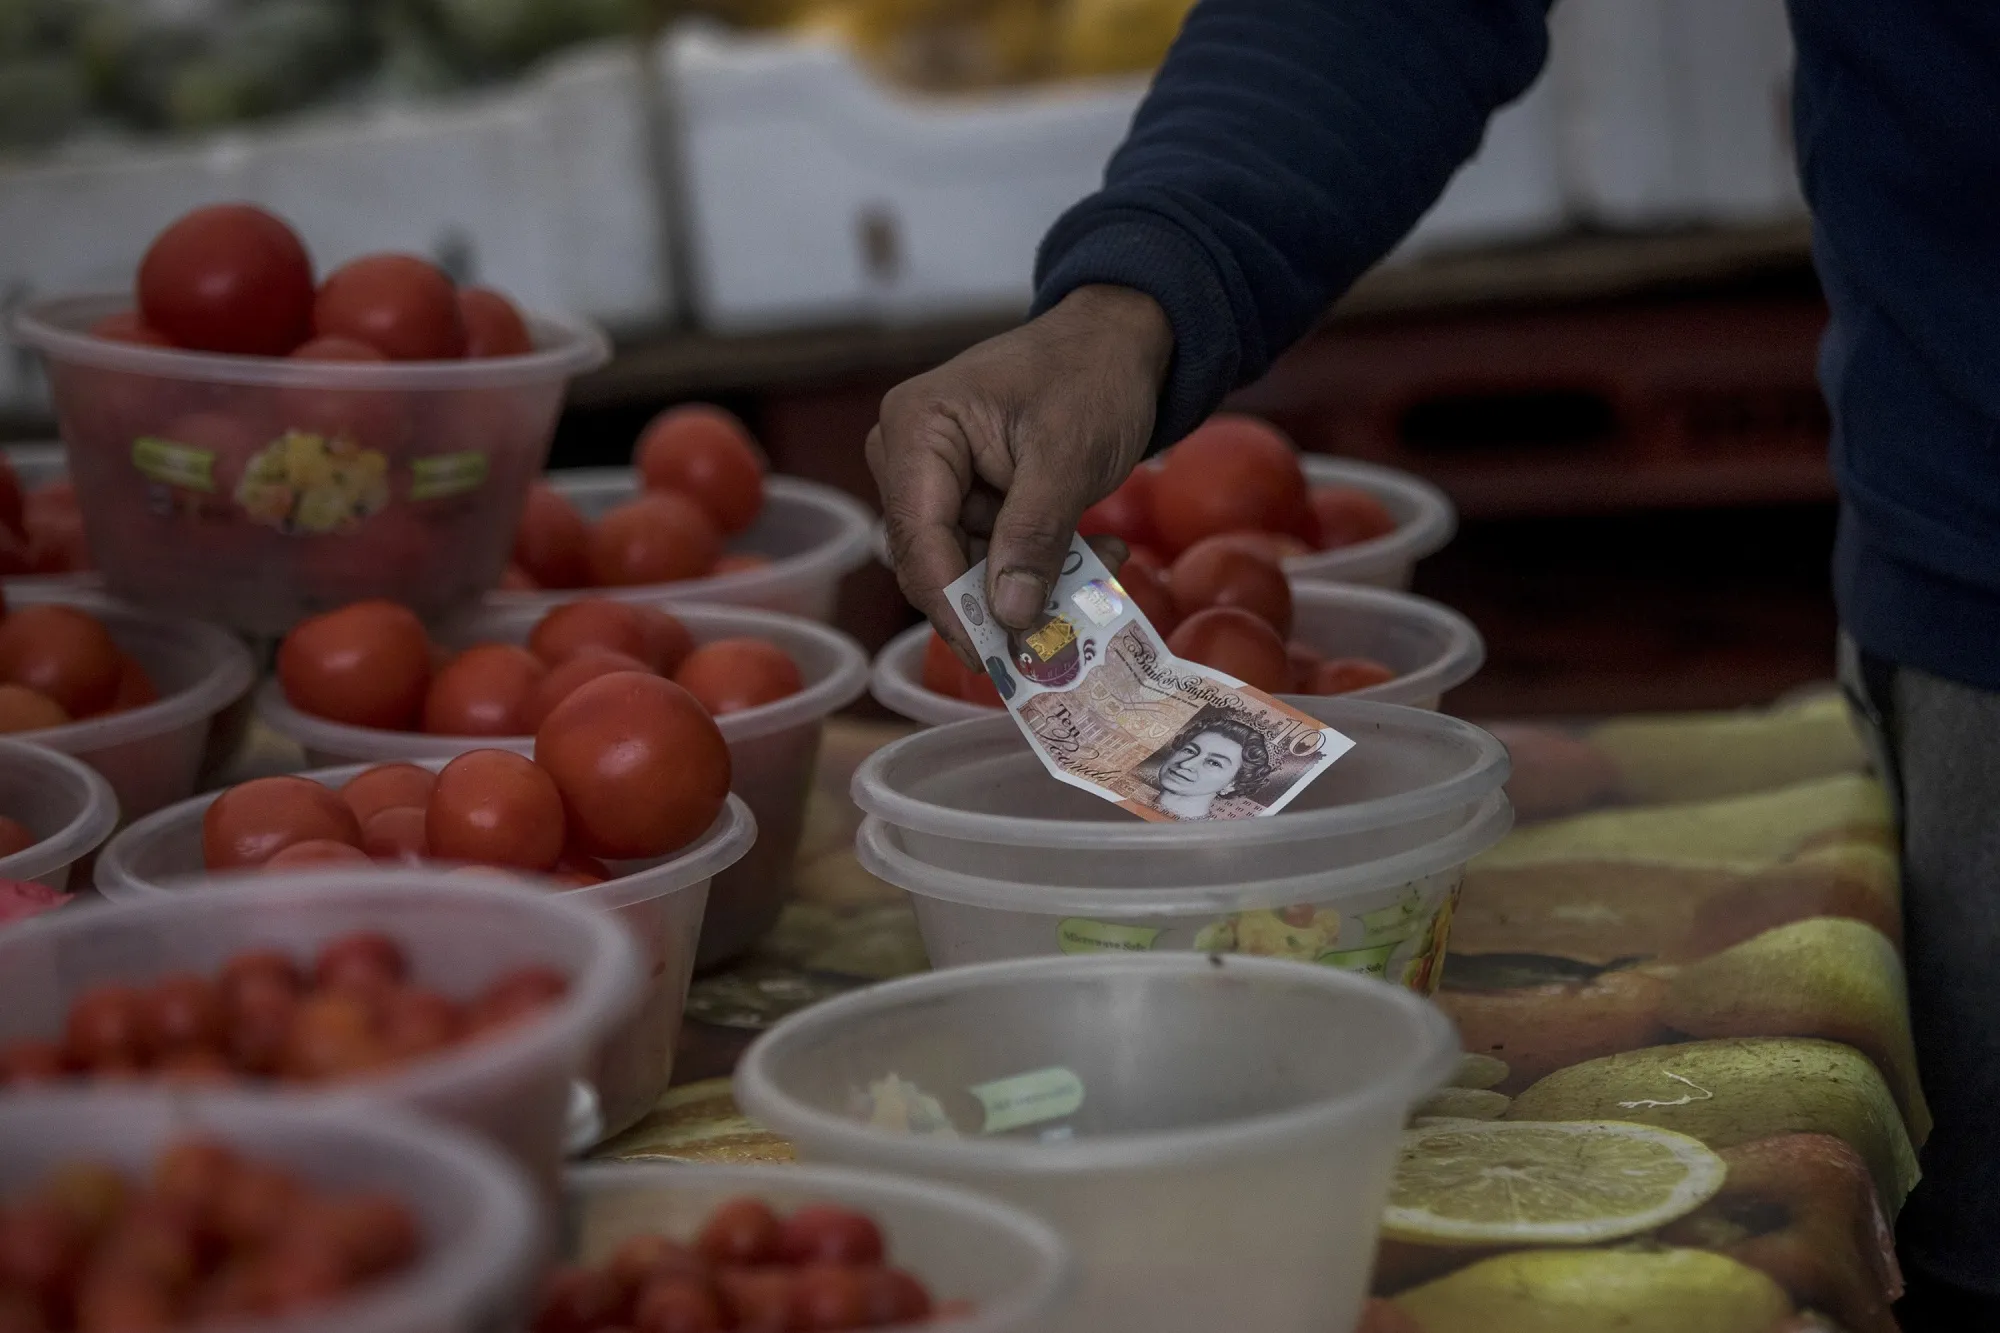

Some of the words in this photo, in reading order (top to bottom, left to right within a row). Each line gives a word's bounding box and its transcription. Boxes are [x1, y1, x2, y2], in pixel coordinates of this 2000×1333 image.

[1123, 629, 1172, 682] Bank
[1173, 674, 1244, 709] England
[1046, 703, 1081, 738] Ten
[1270, 717, 1327, 757] 10
[1019, 706, 1122, 782] Pounds
[1063, 931, 1121, 948] Microwave
